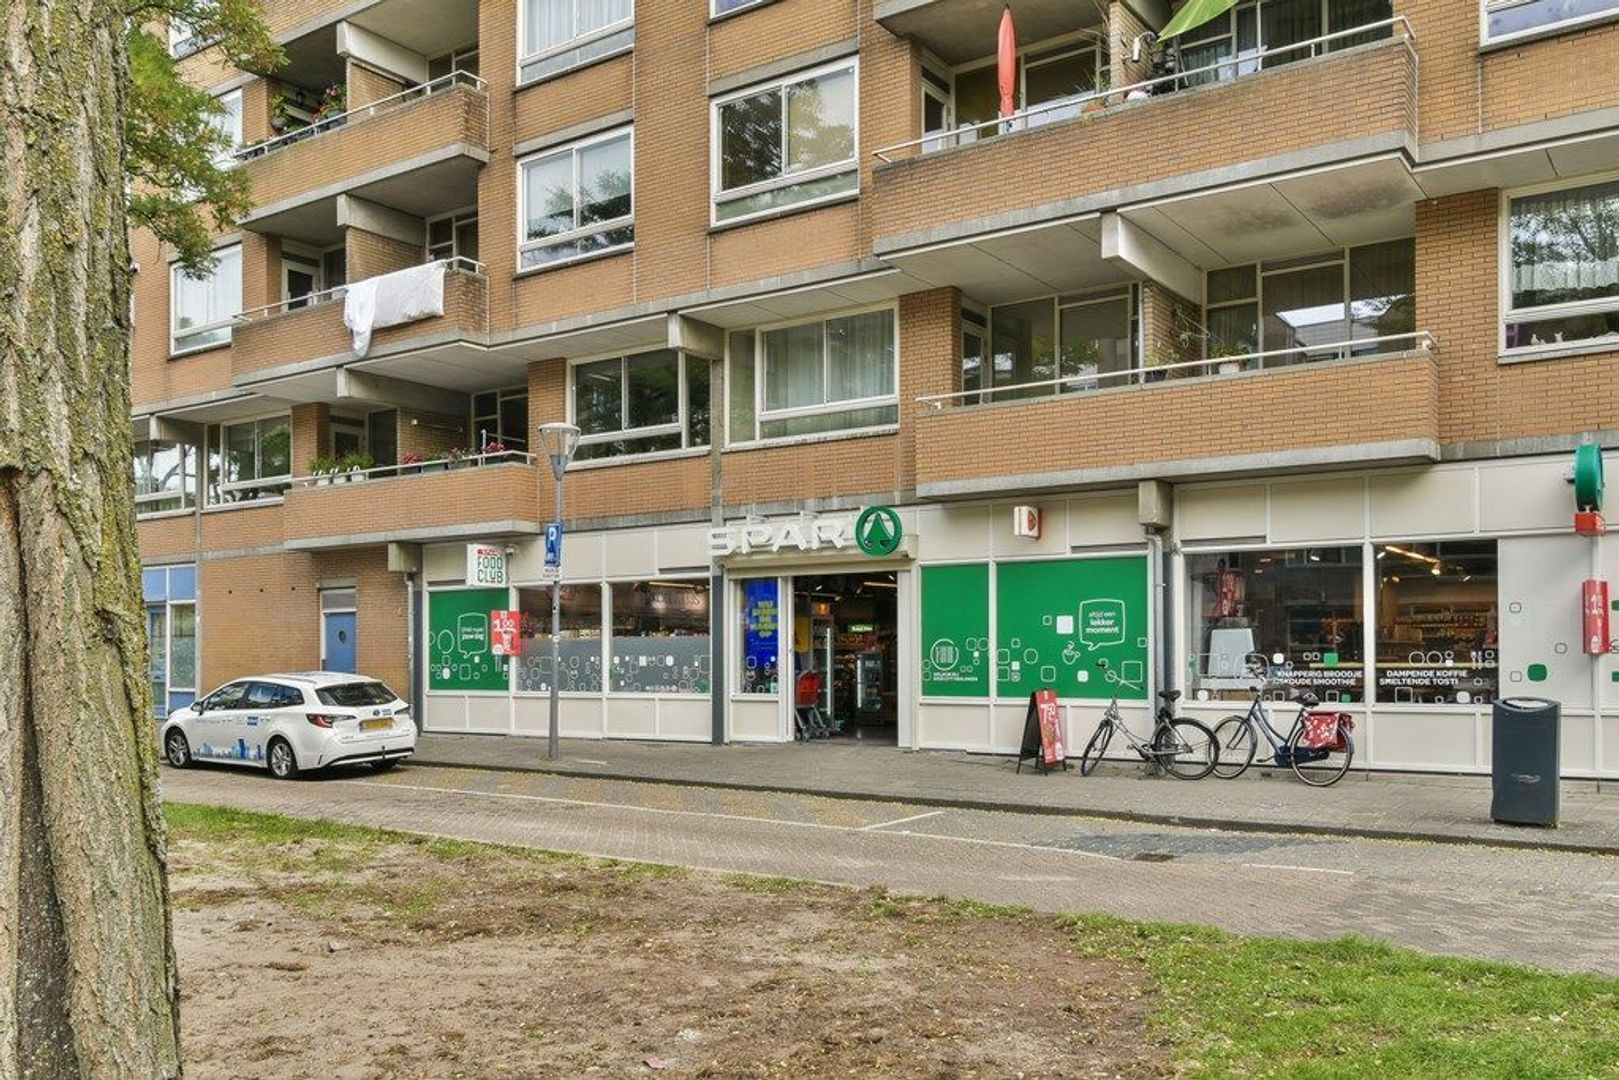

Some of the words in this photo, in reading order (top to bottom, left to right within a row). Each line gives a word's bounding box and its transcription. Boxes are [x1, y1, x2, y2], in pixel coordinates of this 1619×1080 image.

[708, 519, 846, 556] SPAR
[478, 556, 504, 569] FOOD
[478, 569, 504, 583] CLUB
[1090, 618, 1115, 626] lekker
[1085, 626, 1120, 634] moment
[1323, 670, 1363, 678] BROODJE
